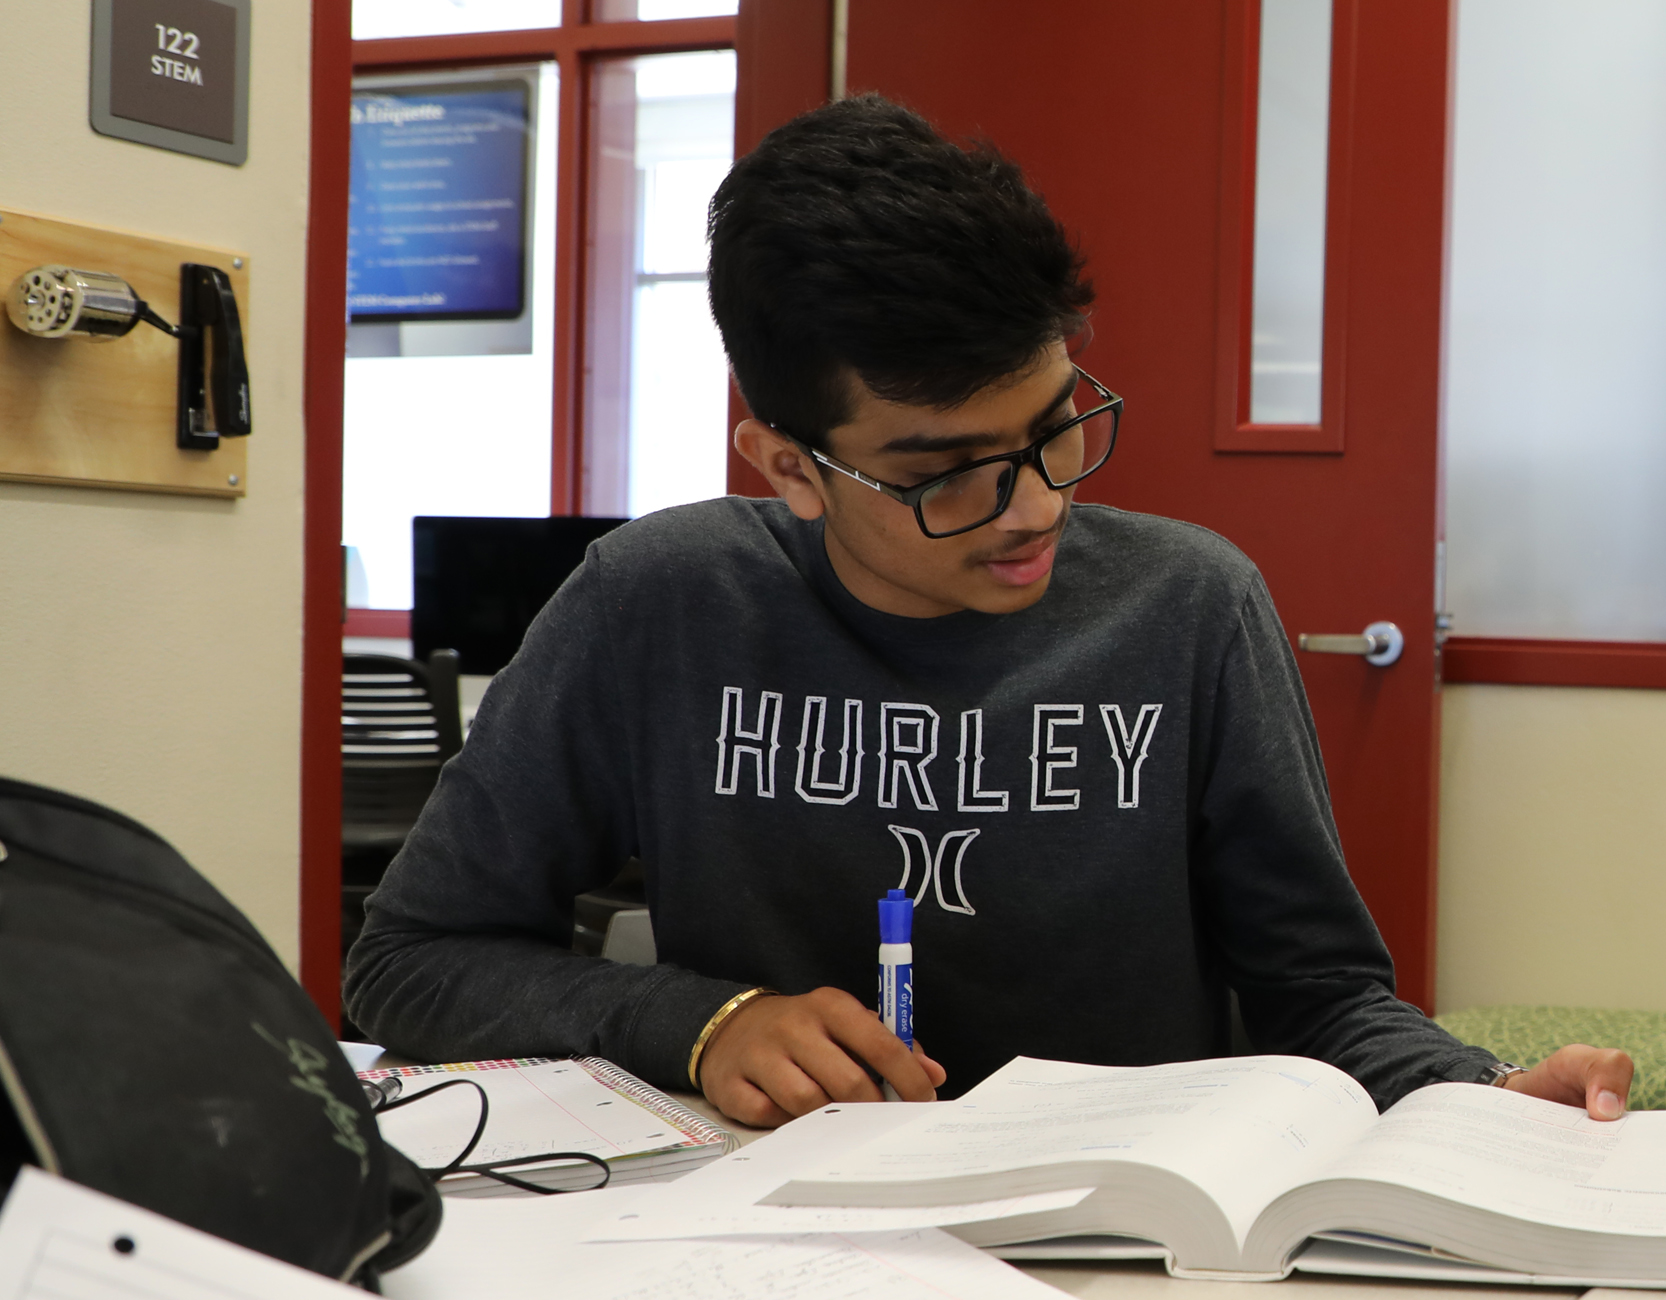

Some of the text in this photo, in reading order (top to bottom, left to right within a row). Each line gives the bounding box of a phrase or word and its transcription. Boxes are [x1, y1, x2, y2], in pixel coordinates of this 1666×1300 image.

[155, 23, 200, 59] 122
[150, 54, 204, 86] STEM
[715, 685, 1163, 813] HURLEY
[899, 993, 909, 1008] dry
